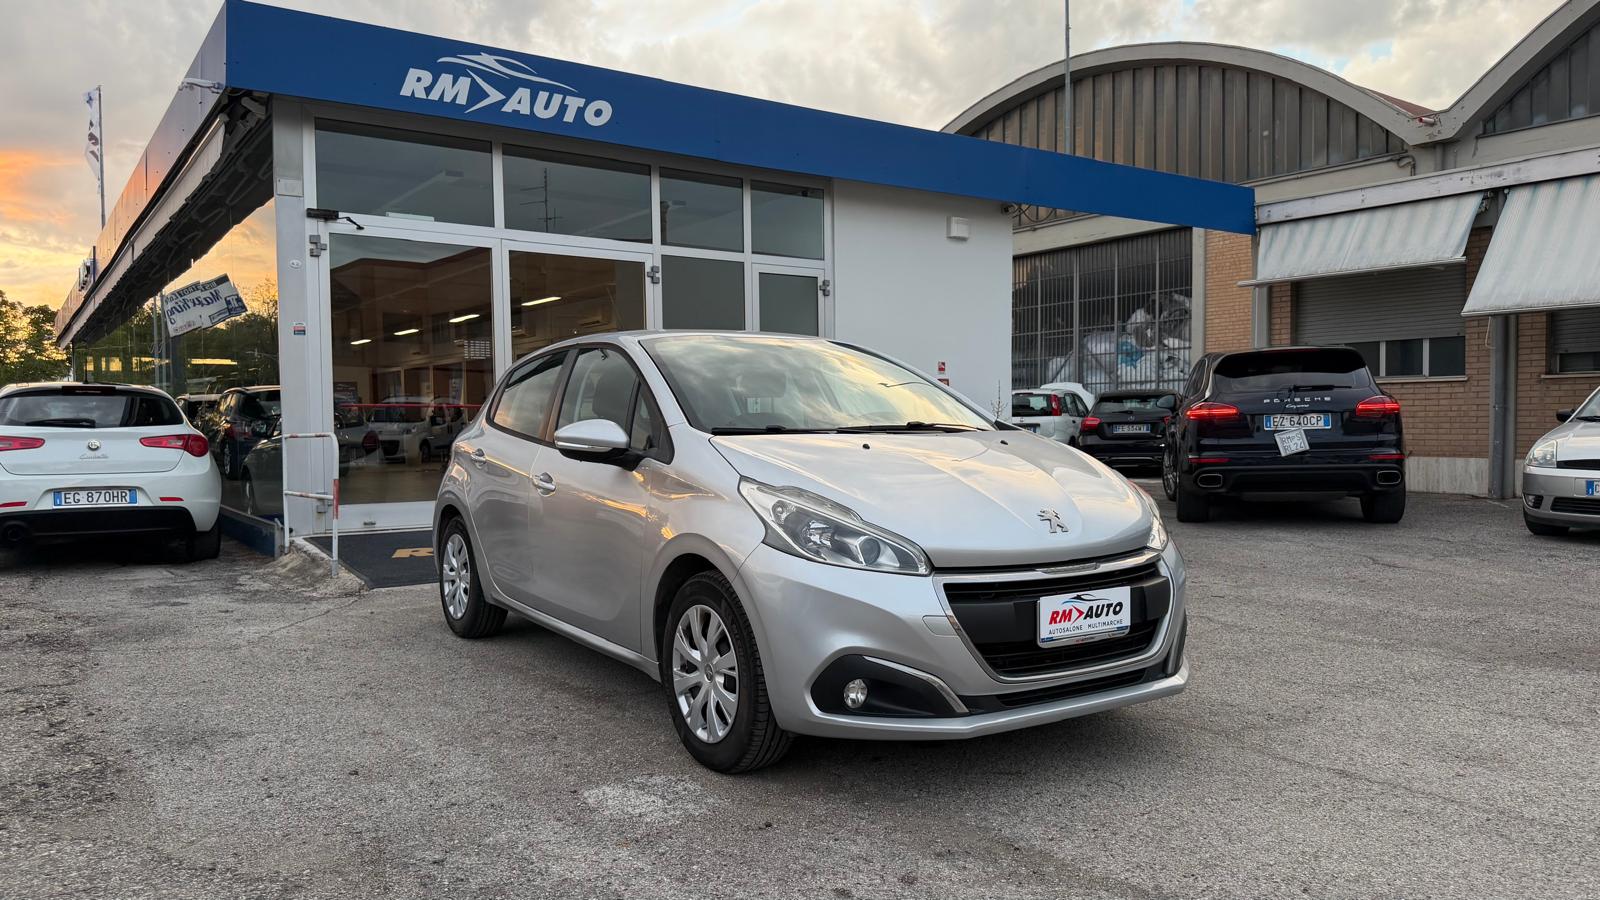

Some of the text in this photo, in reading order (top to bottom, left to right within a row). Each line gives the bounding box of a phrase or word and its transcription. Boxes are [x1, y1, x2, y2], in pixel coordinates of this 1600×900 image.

[400, 67, 613, 127] RM AUTO
[1049, 601, 1124, 625] RM AUTO
[1049, 625, 1083, 635] AUTOSALONE
[1087, 619, 1123, 630] MULTIMARCHE
